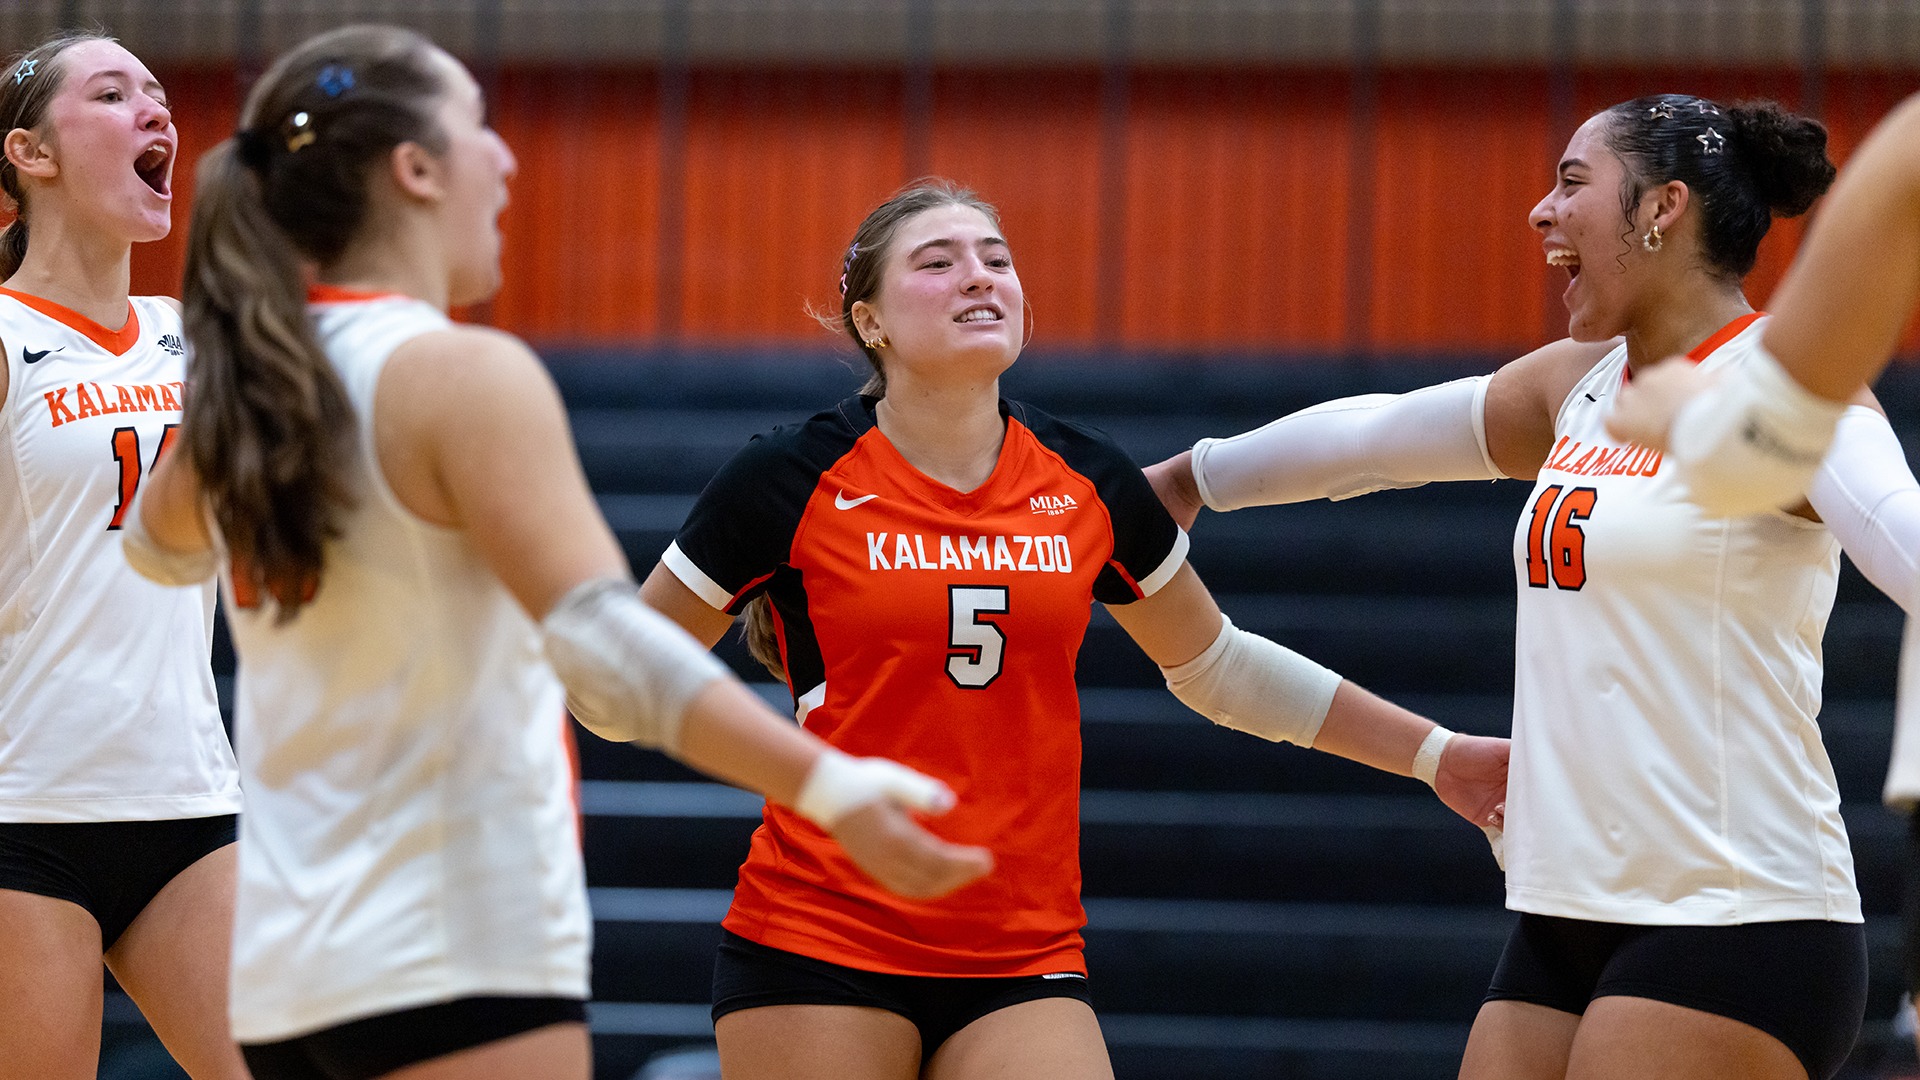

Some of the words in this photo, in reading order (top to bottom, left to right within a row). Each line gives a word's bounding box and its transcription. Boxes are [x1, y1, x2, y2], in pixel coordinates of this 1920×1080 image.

[1540, 435, 1664, 478] ALAMAZOO
[1029, 494, 1077, 511] MIAA
[866, 532, 1073, 574] KALAMAZOO
[1526, 484, 1598, 592] 16
[944, 584, 1010, 690] 5
